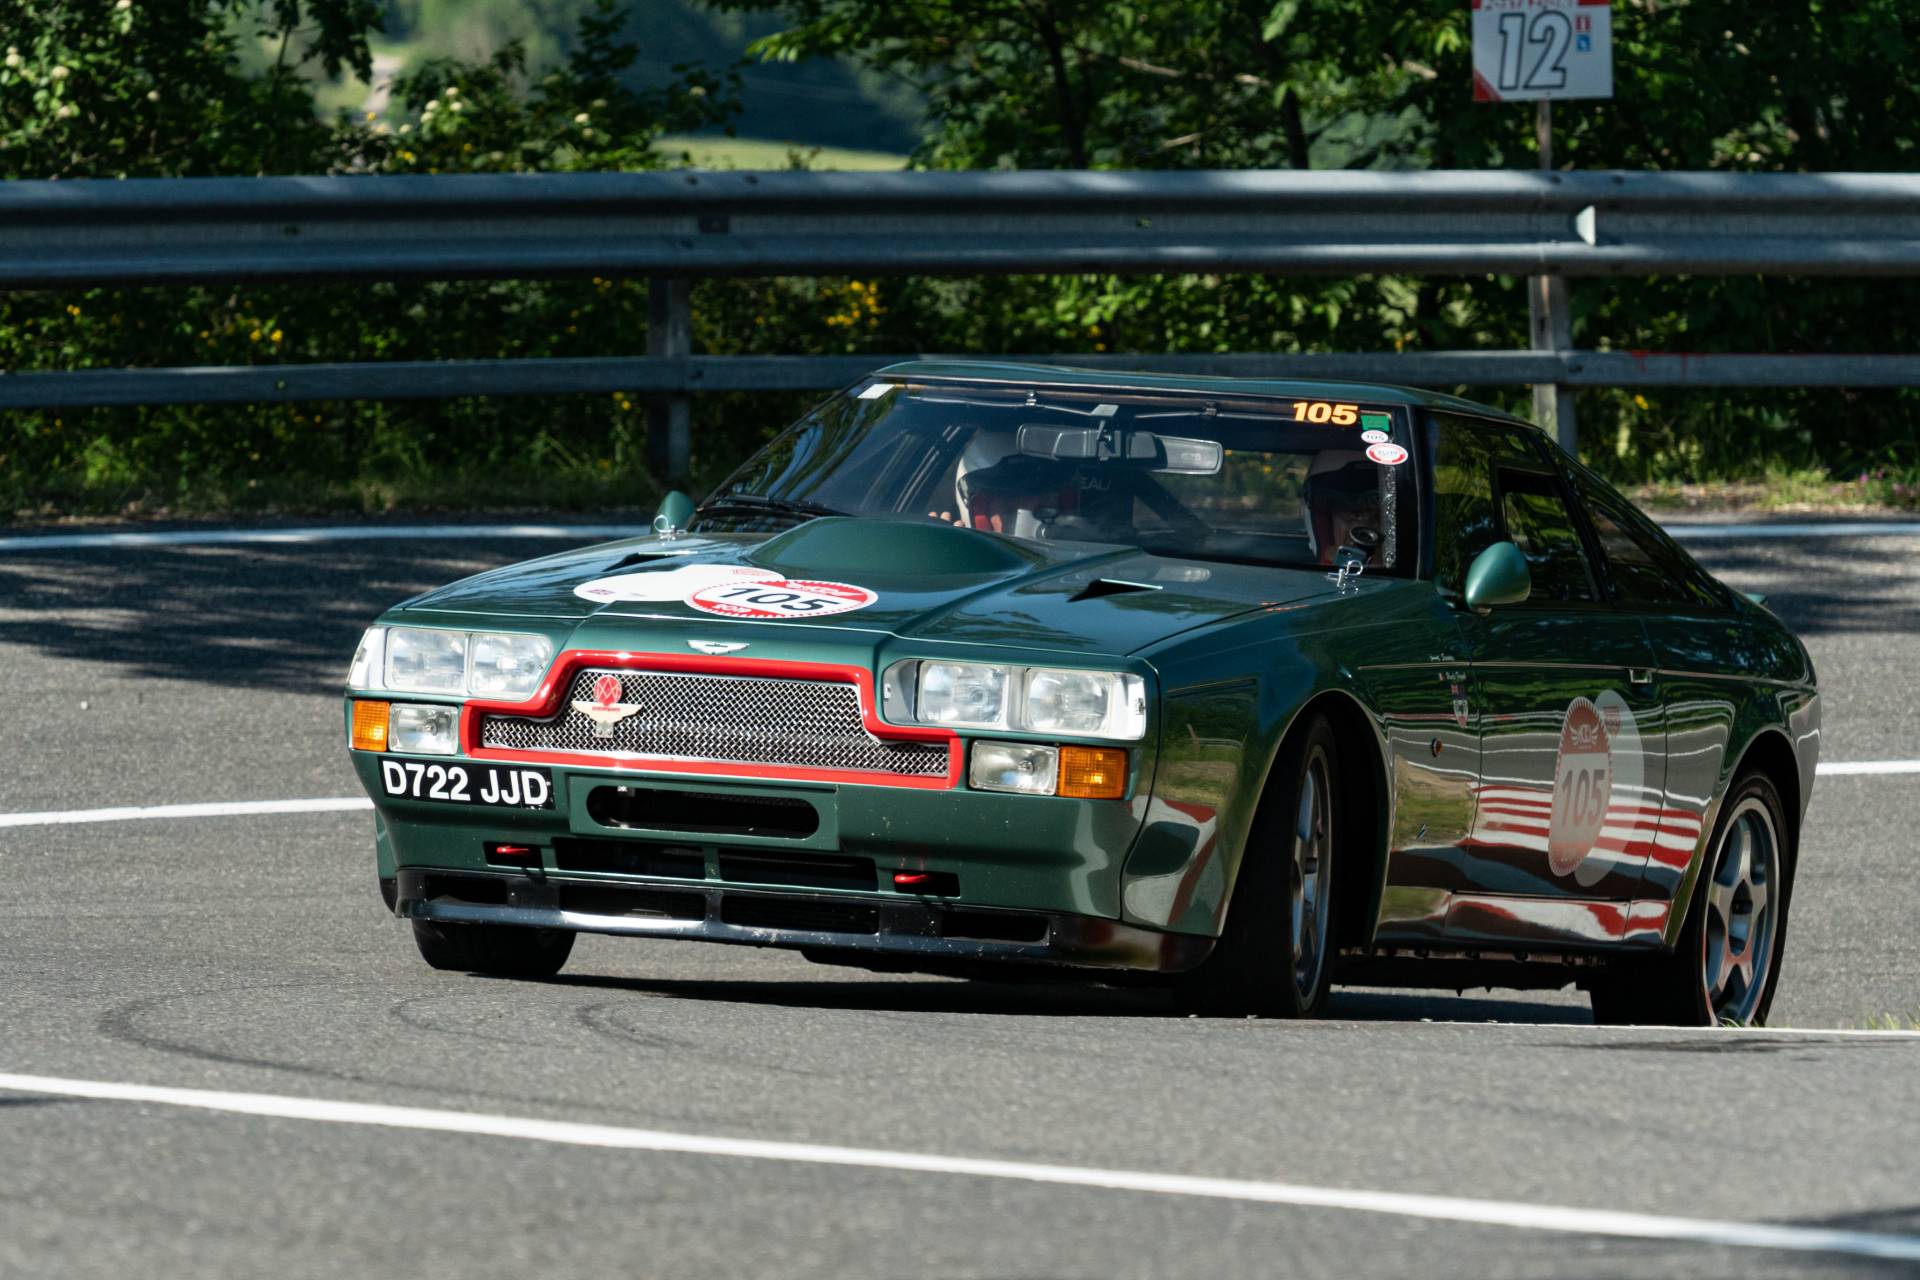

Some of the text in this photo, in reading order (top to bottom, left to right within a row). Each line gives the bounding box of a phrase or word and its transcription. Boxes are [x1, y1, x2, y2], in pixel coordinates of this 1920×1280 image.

[1498, 10, 1572, 91] 12
[1293, 402, 1359, 425] 105
[719, 587, 841, 611] 105
[382, 760, 548, 805] D722 JJD
[1561, 768, 1606, 828] 105
